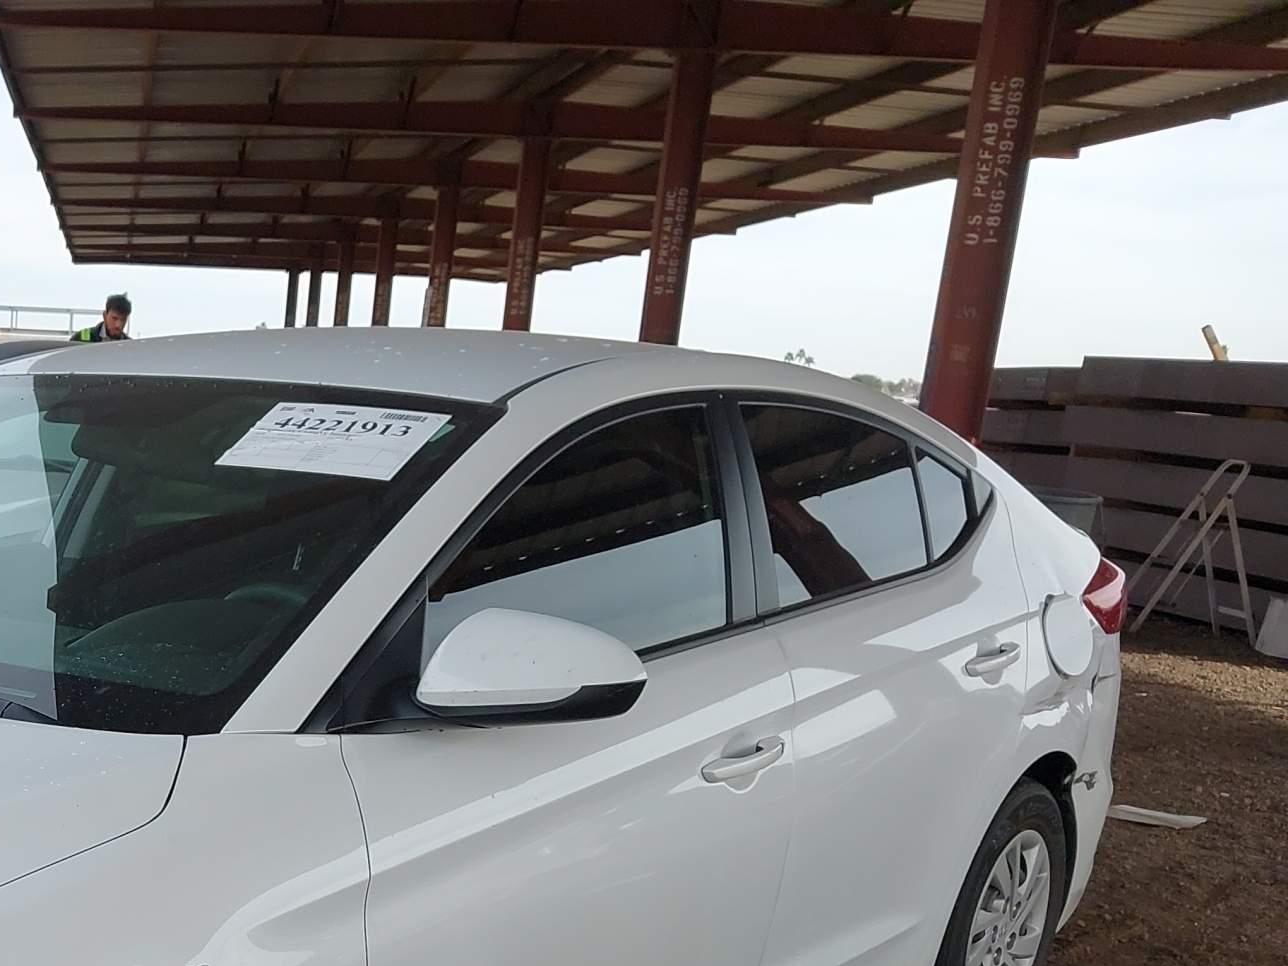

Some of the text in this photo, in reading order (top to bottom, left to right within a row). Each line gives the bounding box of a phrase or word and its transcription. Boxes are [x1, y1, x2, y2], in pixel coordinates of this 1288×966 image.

[972, 122, 999, 198] PREFAB
[988, 75, 1008, 112] INC.
[982, 77, 1025, 243] 1-866-799-0969
[274, 416, 413, 438] 44221913
